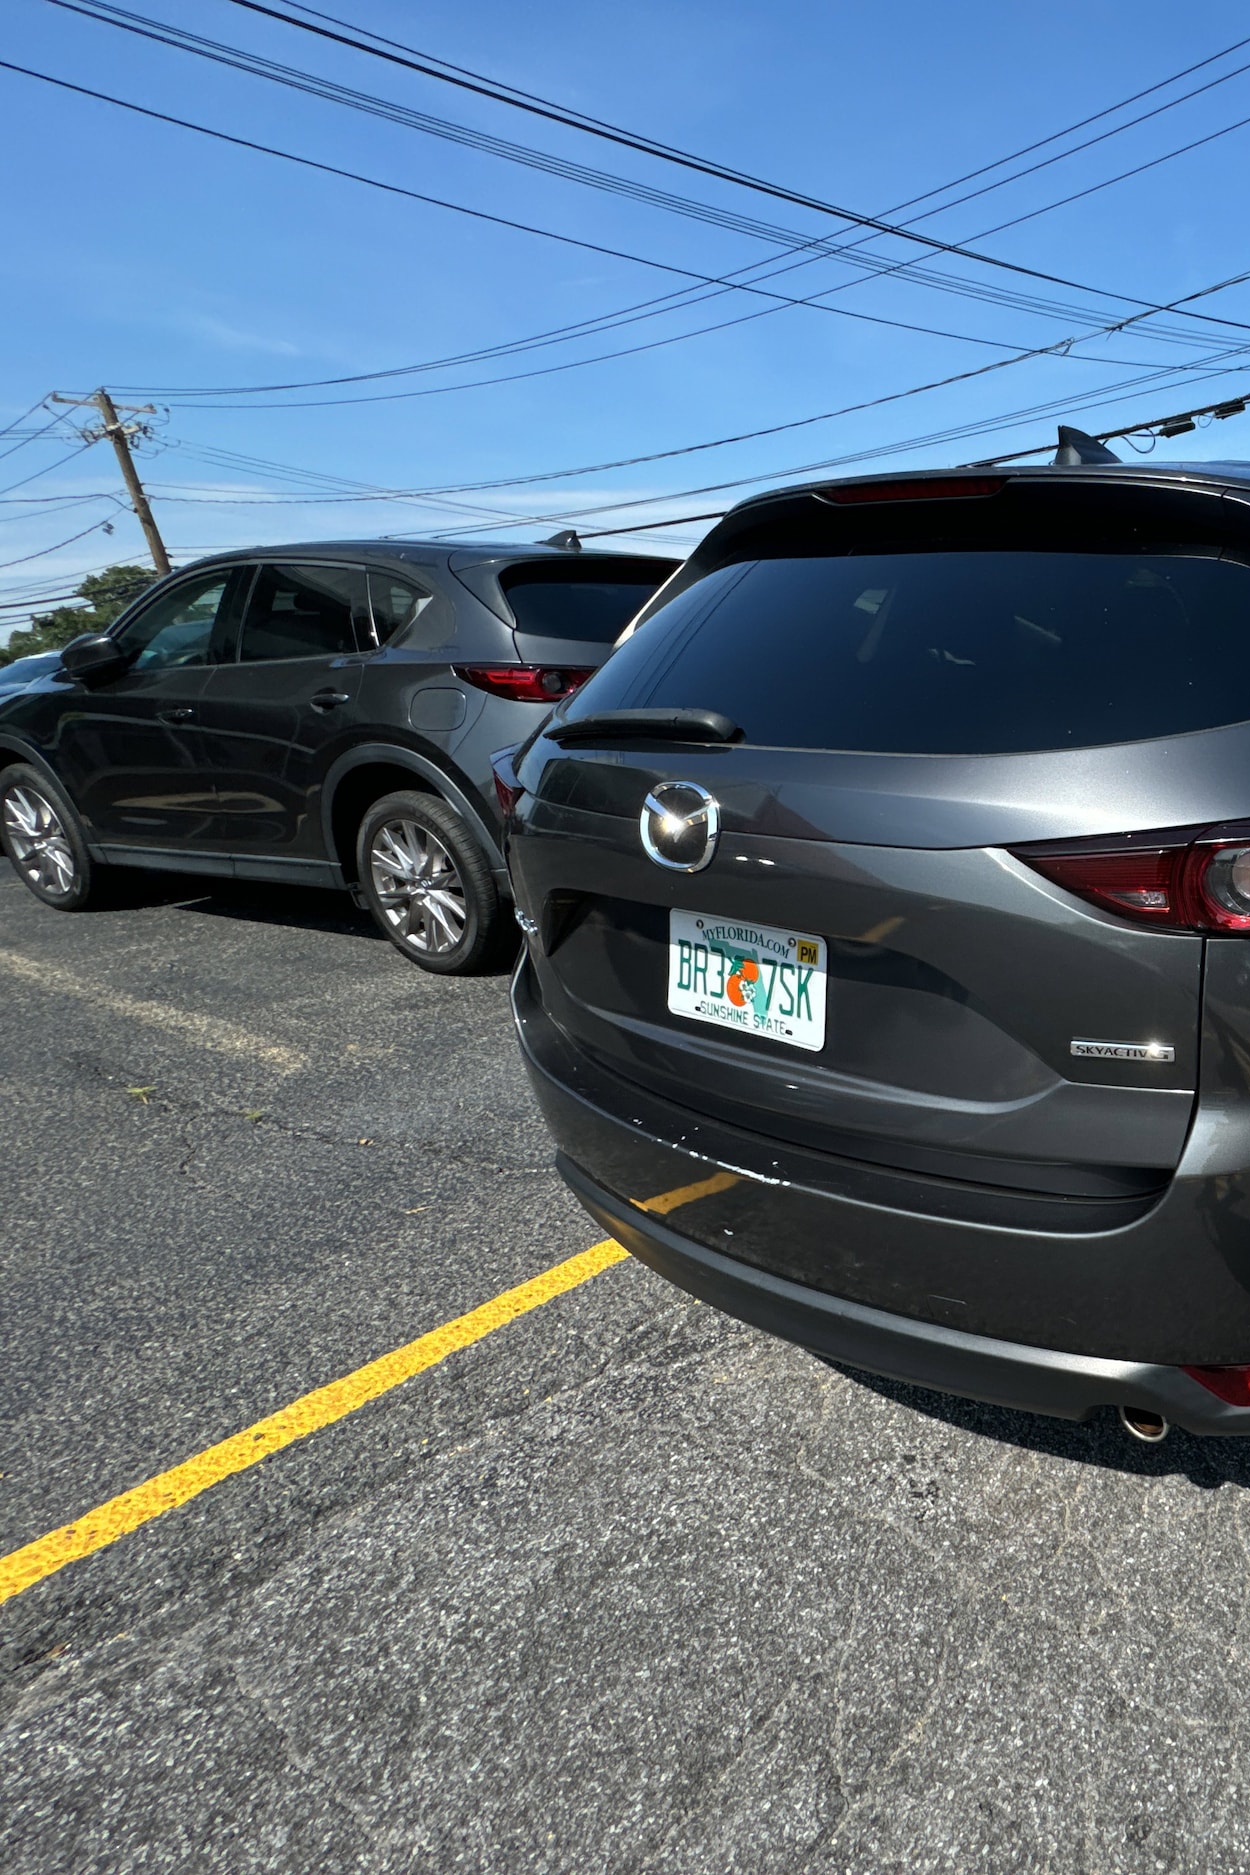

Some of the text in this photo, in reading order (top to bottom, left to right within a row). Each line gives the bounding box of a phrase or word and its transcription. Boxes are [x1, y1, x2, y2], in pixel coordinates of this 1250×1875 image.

[702, 925, 791, 959] MYFLORIDA.COM
[800, 946, 817, 964] PM
[699, 1001, 786, 1035] SUNSHINE STATE
